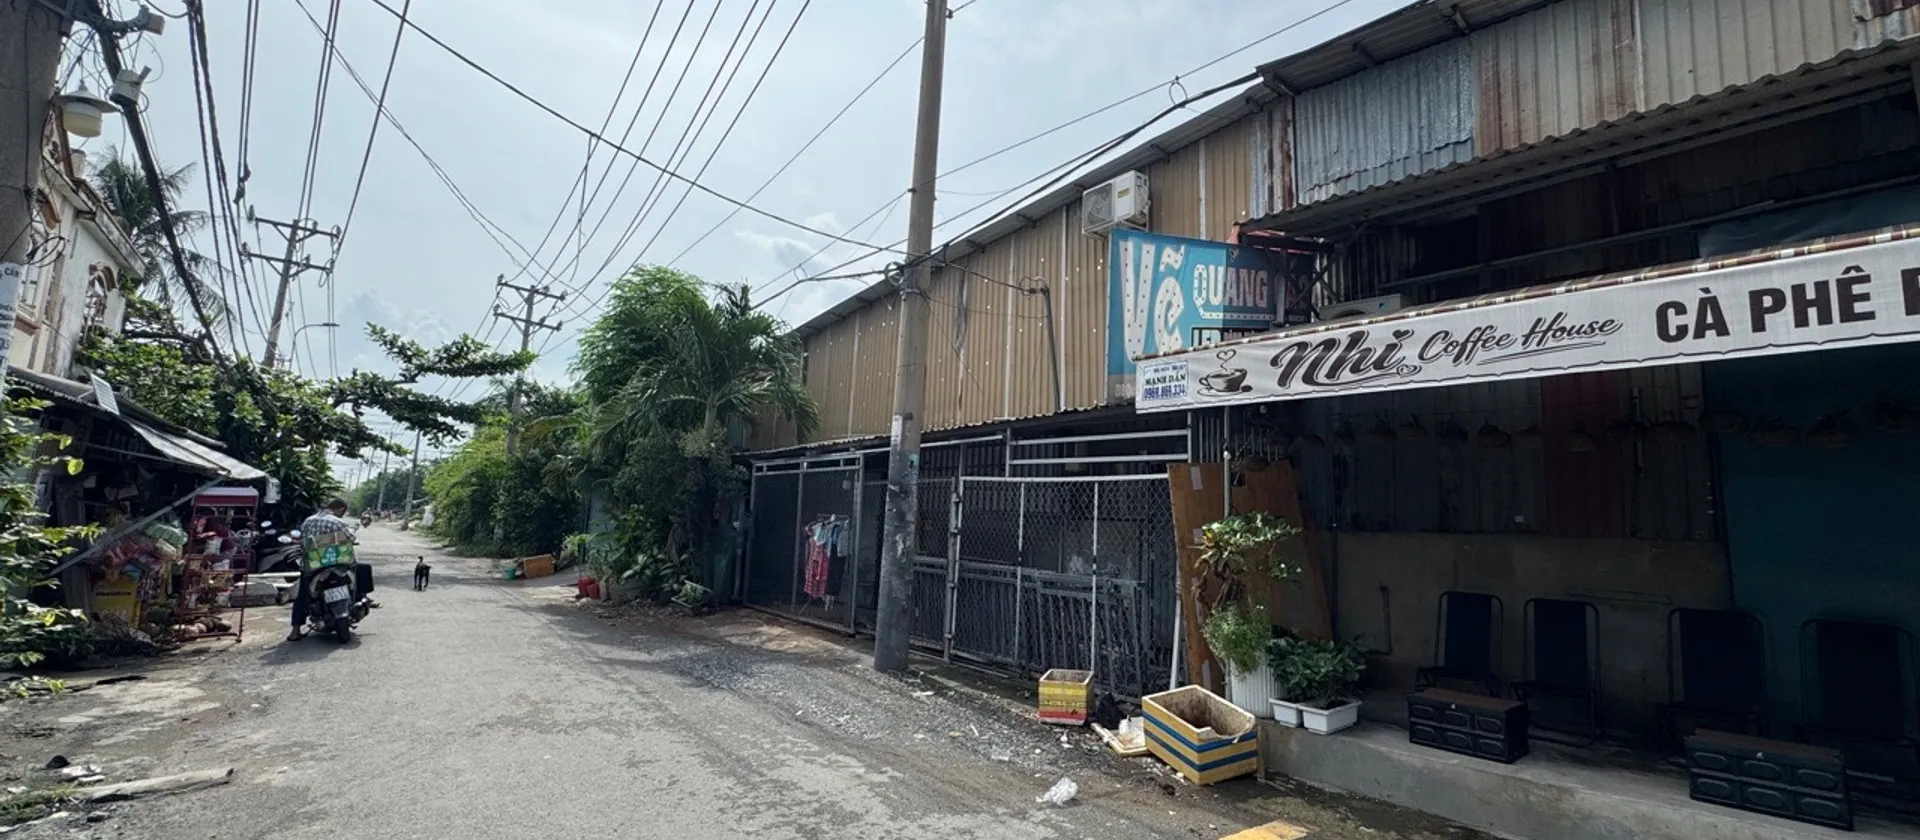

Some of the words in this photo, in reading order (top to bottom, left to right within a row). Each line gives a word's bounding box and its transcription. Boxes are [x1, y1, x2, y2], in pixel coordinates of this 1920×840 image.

[1118, 240, 1186, 362] Vẽ
[1655, 288, 1730, 343] CÀ
[1748, 265, 1876, 333] PHÊ
[1270, 329, 1416, 388] Nhi
[1418, 326, 1516, 366] Coffee
[1521, 312, 1623, 347] House
